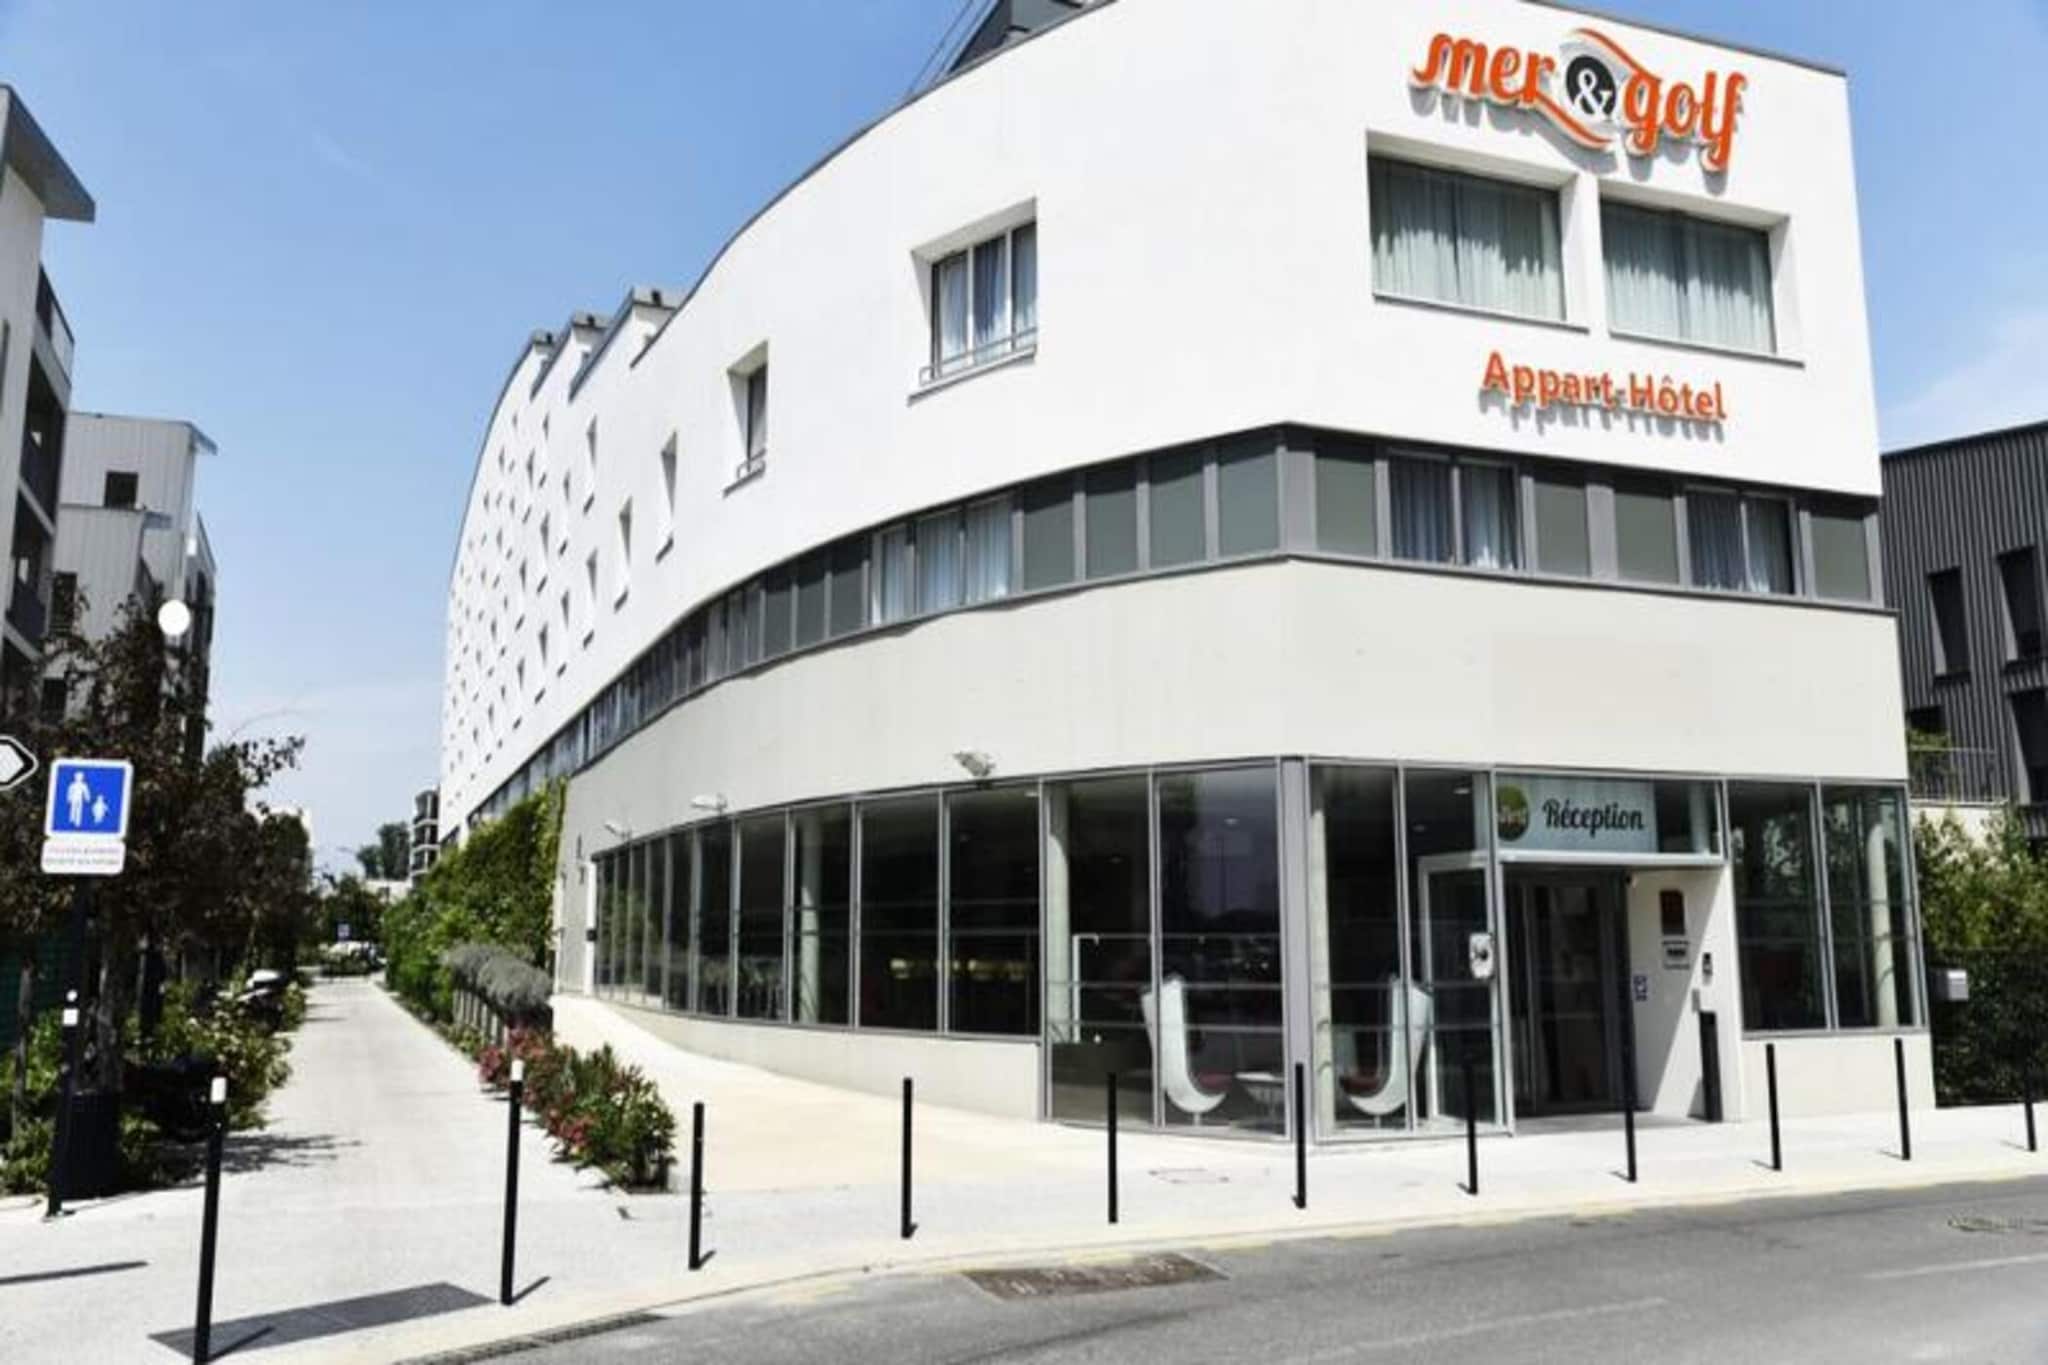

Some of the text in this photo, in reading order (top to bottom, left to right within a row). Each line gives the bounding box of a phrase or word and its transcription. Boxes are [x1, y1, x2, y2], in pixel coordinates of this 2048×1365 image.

[1412, 33, 1747, 172] mer & golf
[1542, 798, 1644, 838] Réception
